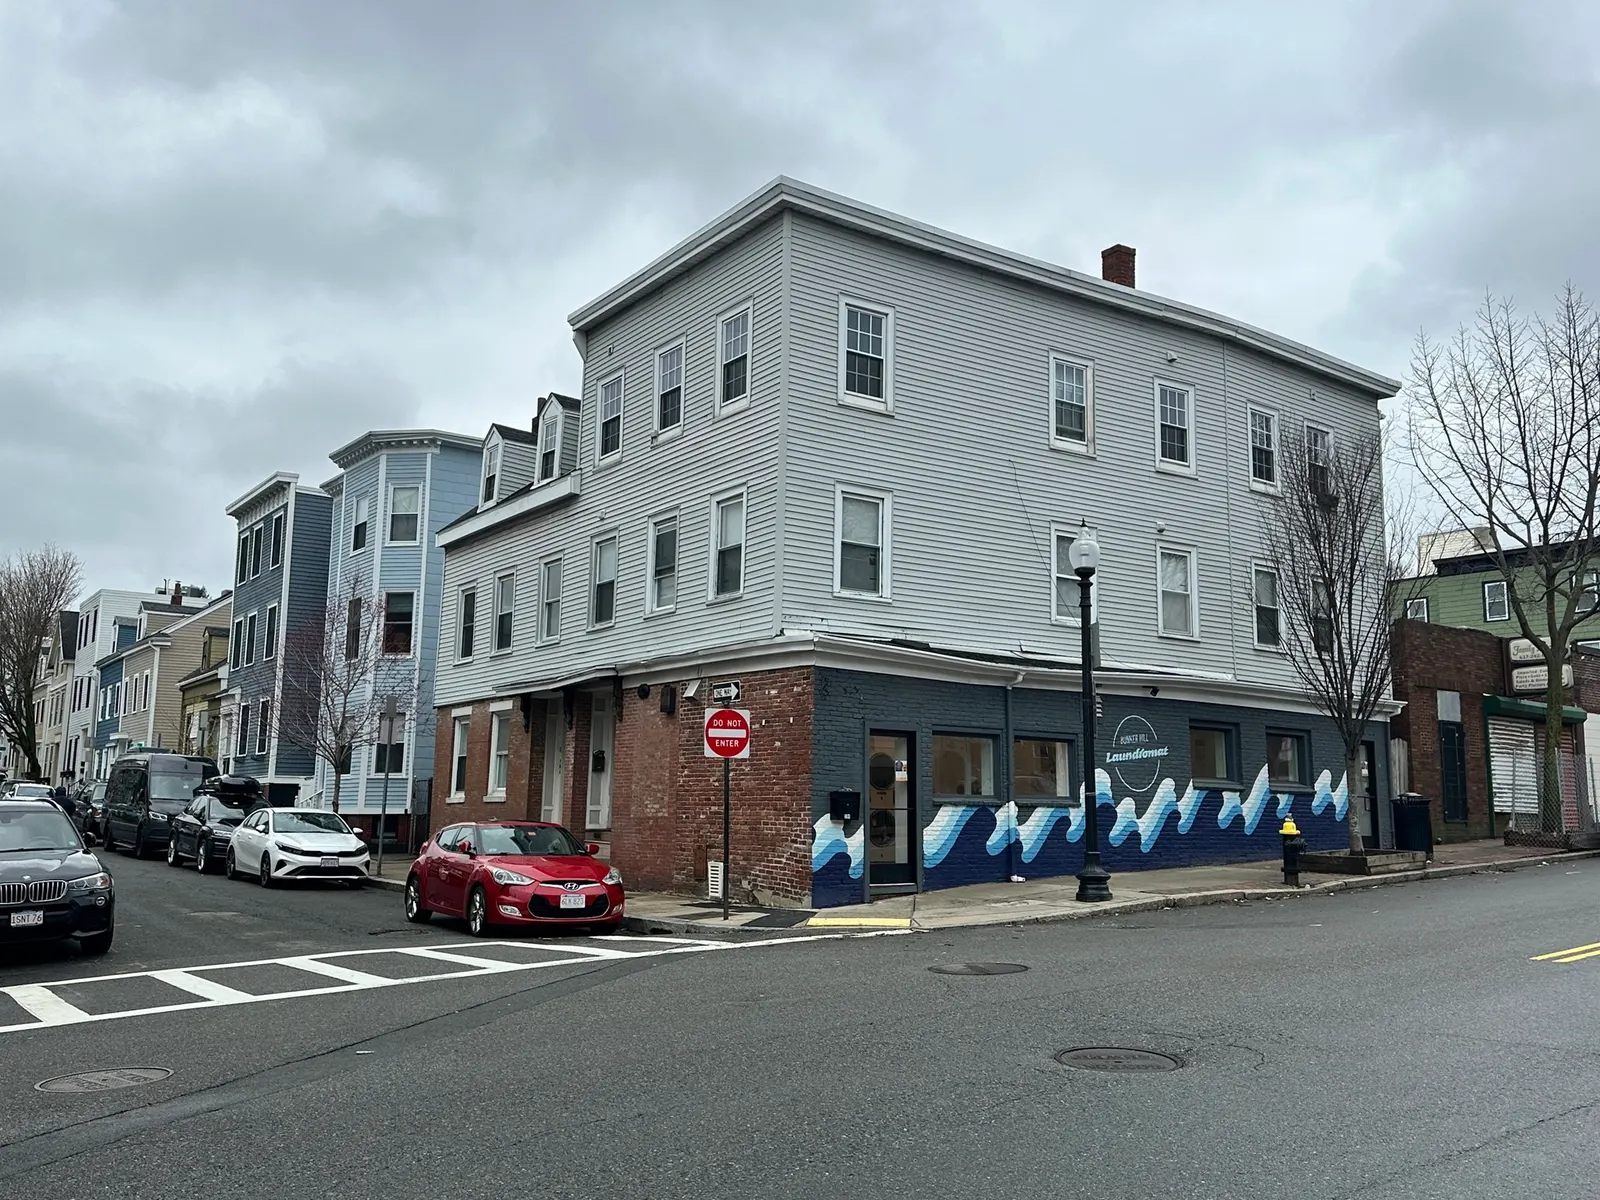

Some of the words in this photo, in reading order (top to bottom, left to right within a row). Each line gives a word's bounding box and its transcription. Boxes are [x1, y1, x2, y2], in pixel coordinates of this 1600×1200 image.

[715, 688, 723, 697] ONE
[713, 719, 723, 727] DO
[727, 719, 742, 727] NOT
[715, 739, 739, 748] ENTER
[1106, 745, 1169, 763] Laundromat
[32, 913, 42, 922] 76
